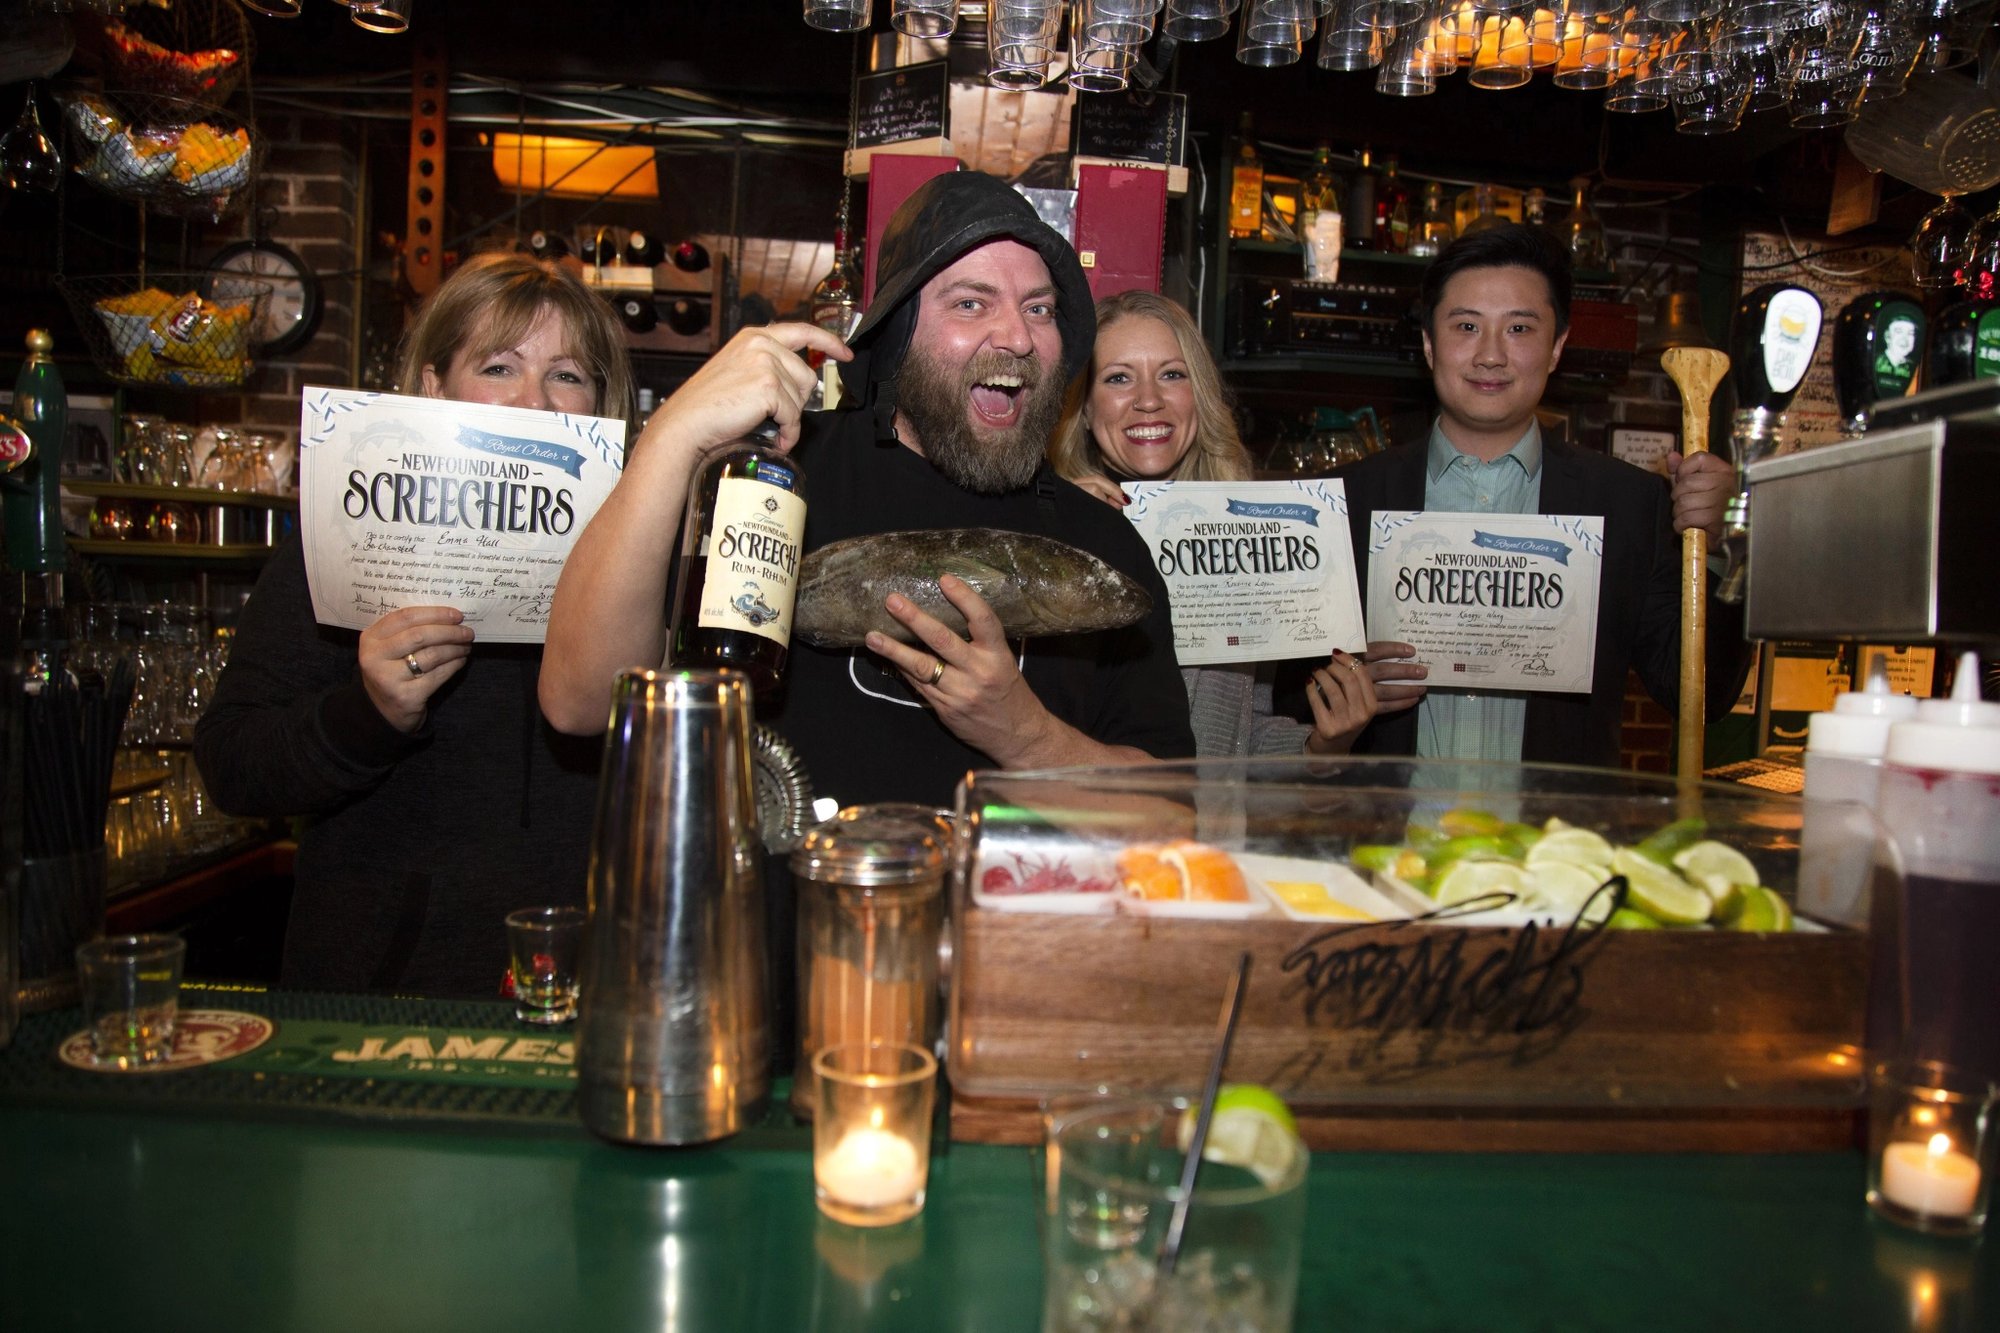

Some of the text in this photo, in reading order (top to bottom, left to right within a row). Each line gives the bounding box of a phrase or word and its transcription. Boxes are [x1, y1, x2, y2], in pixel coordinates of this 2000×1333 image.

[488, 438, 519, 453] Royal
[522, 441, 560, 461] Order
[401, 453, 530, 480] NEWFOUNDLAND
[343, 470, 576, 536] SCREECHERS
[1247, 505, 1272, 517] Royal
[1272, 506, 1300, 517] Order
[437, 531, 468, 545] Emma
[743, 521, 789, 541] NEWFOUNDLAND
[1193, 522, 1282, 536] NEWFOUNDLAND
[718, 524, 798, 578] SCREECH
[1493, 538, 1518, 549] Royal
[1519, 540, 1550, 552] Order
[1158, 535, 1321, 576] SCREECHERS
[1434, 553, 1528, 569] NEWFOUNDLAND
[493, 575, 520, 588] Emma
[1395, 566, 1564, 609] SCREECHERS
